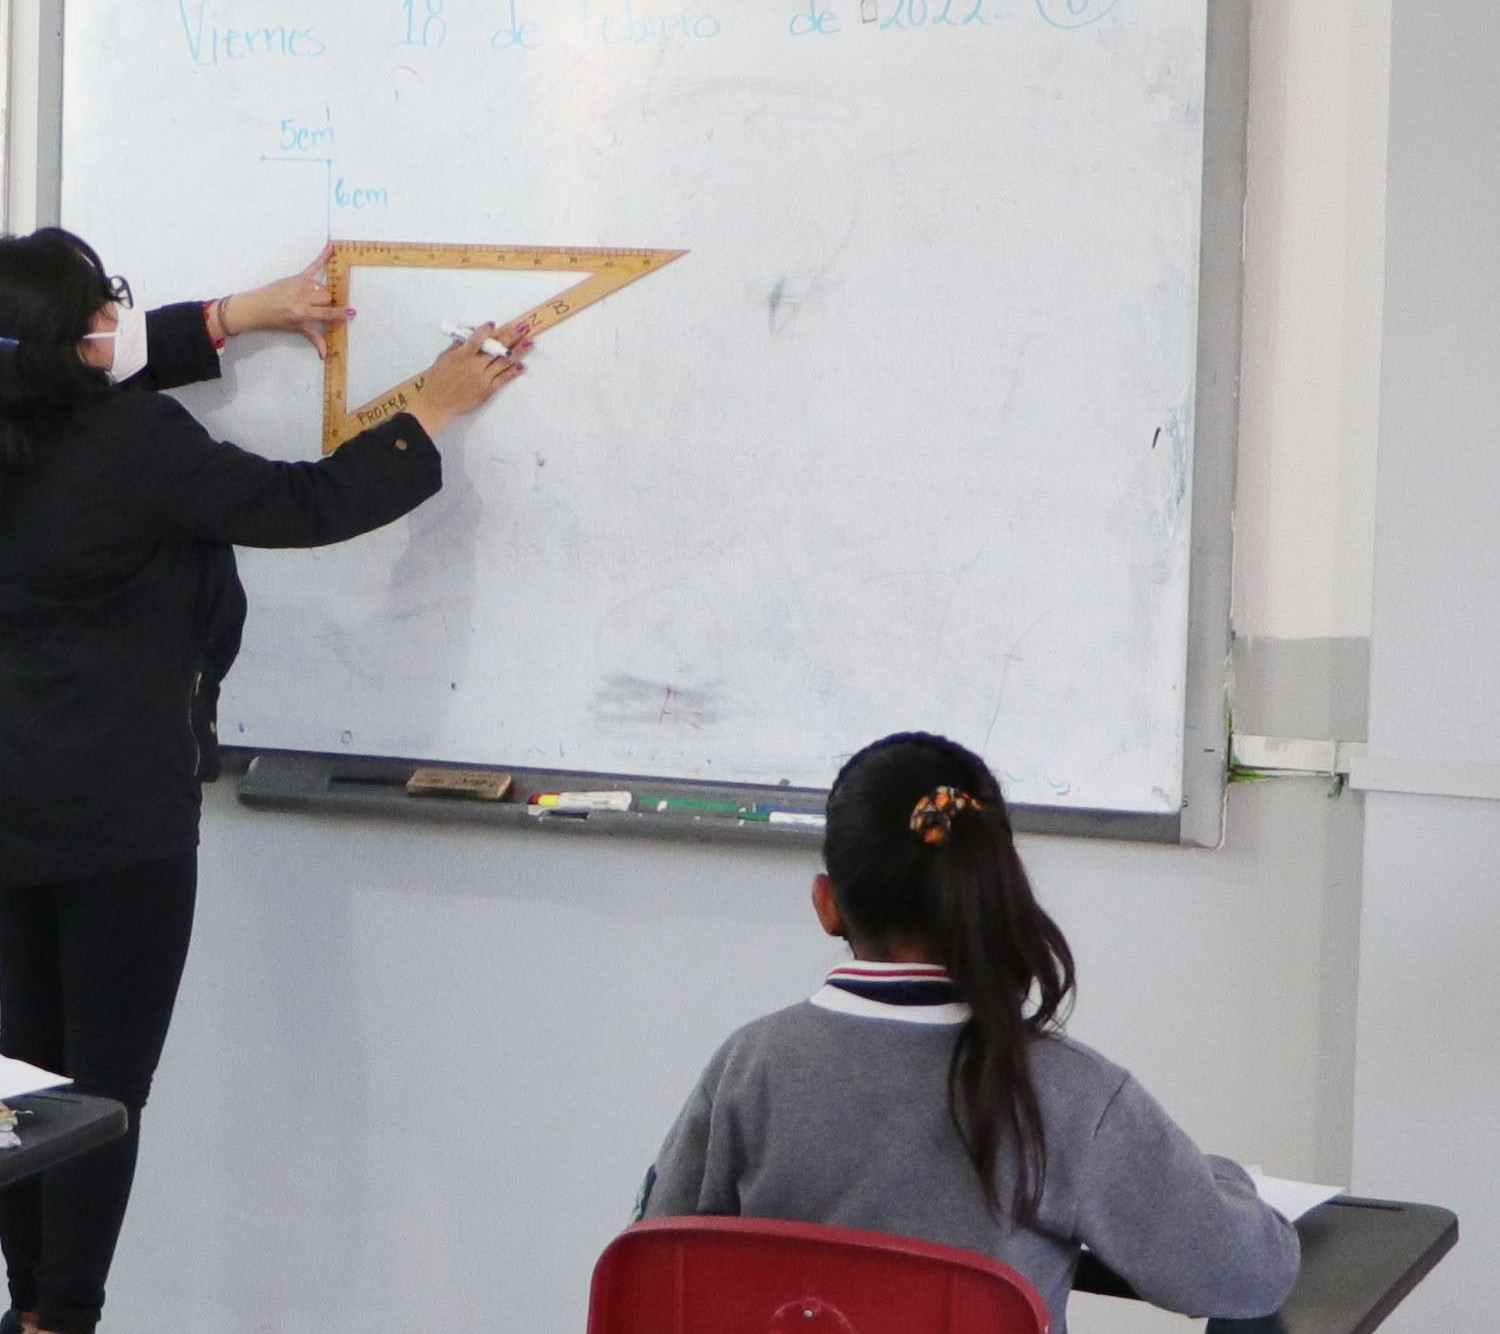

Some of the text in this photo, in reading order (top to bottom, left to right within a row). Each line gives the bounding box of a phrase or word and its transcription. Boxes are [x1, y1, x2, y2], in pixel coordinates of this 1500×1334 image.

[279, 119, 335, 151] 5cm
[334, 178, 389, 208] 6cm
[357, 391, 408, 426] PROFRA
